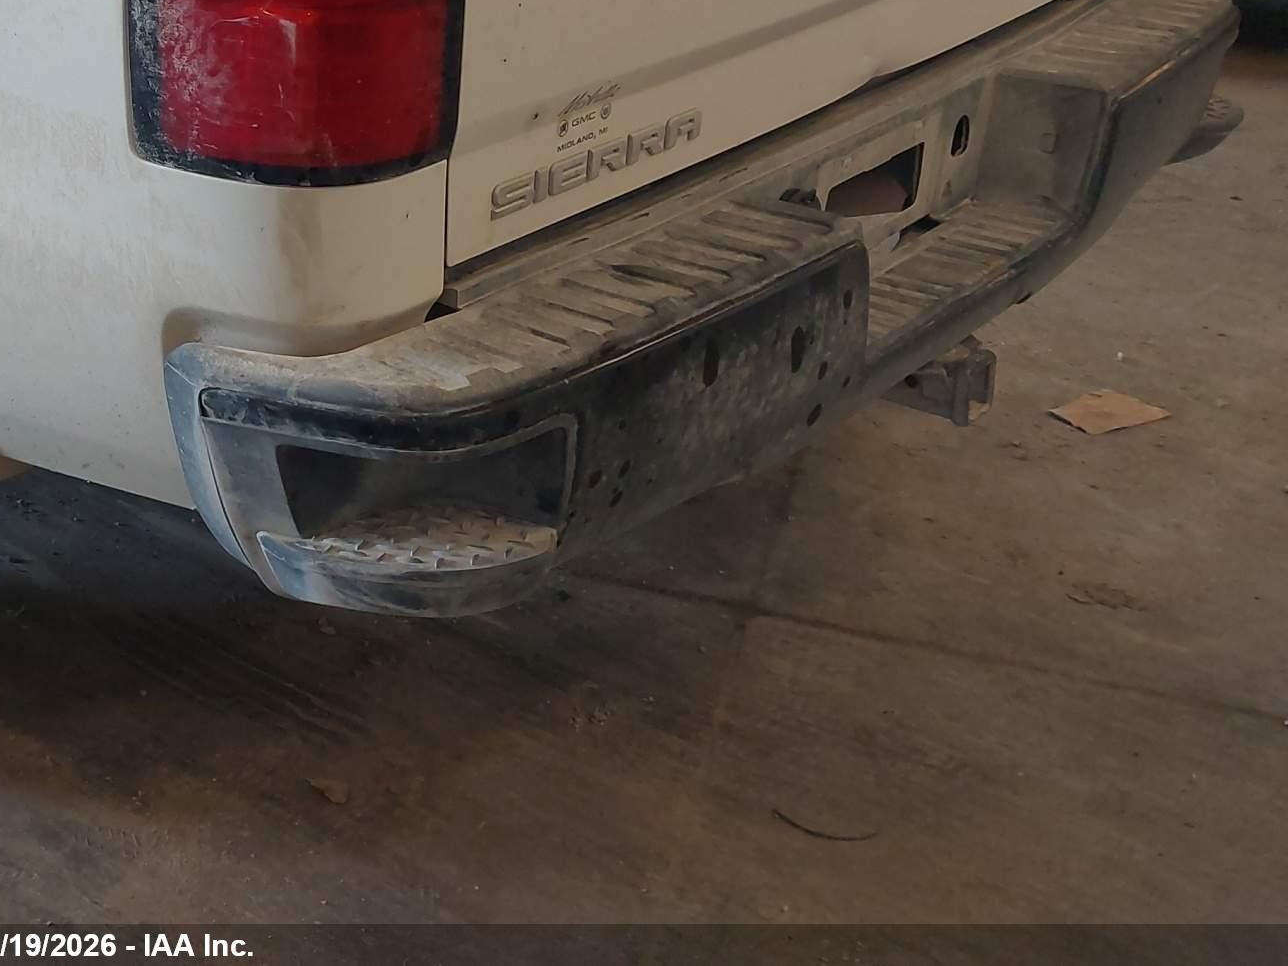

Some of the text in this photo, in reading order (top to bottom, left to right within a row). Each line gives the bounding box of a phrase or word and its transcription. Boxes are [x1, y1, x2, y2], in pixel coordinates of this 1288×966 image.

[571, 111, 596, 128] GMC
[556, 132, 597, 153] MIDLAND,
[490, 107, 702, 221] SIERRA
